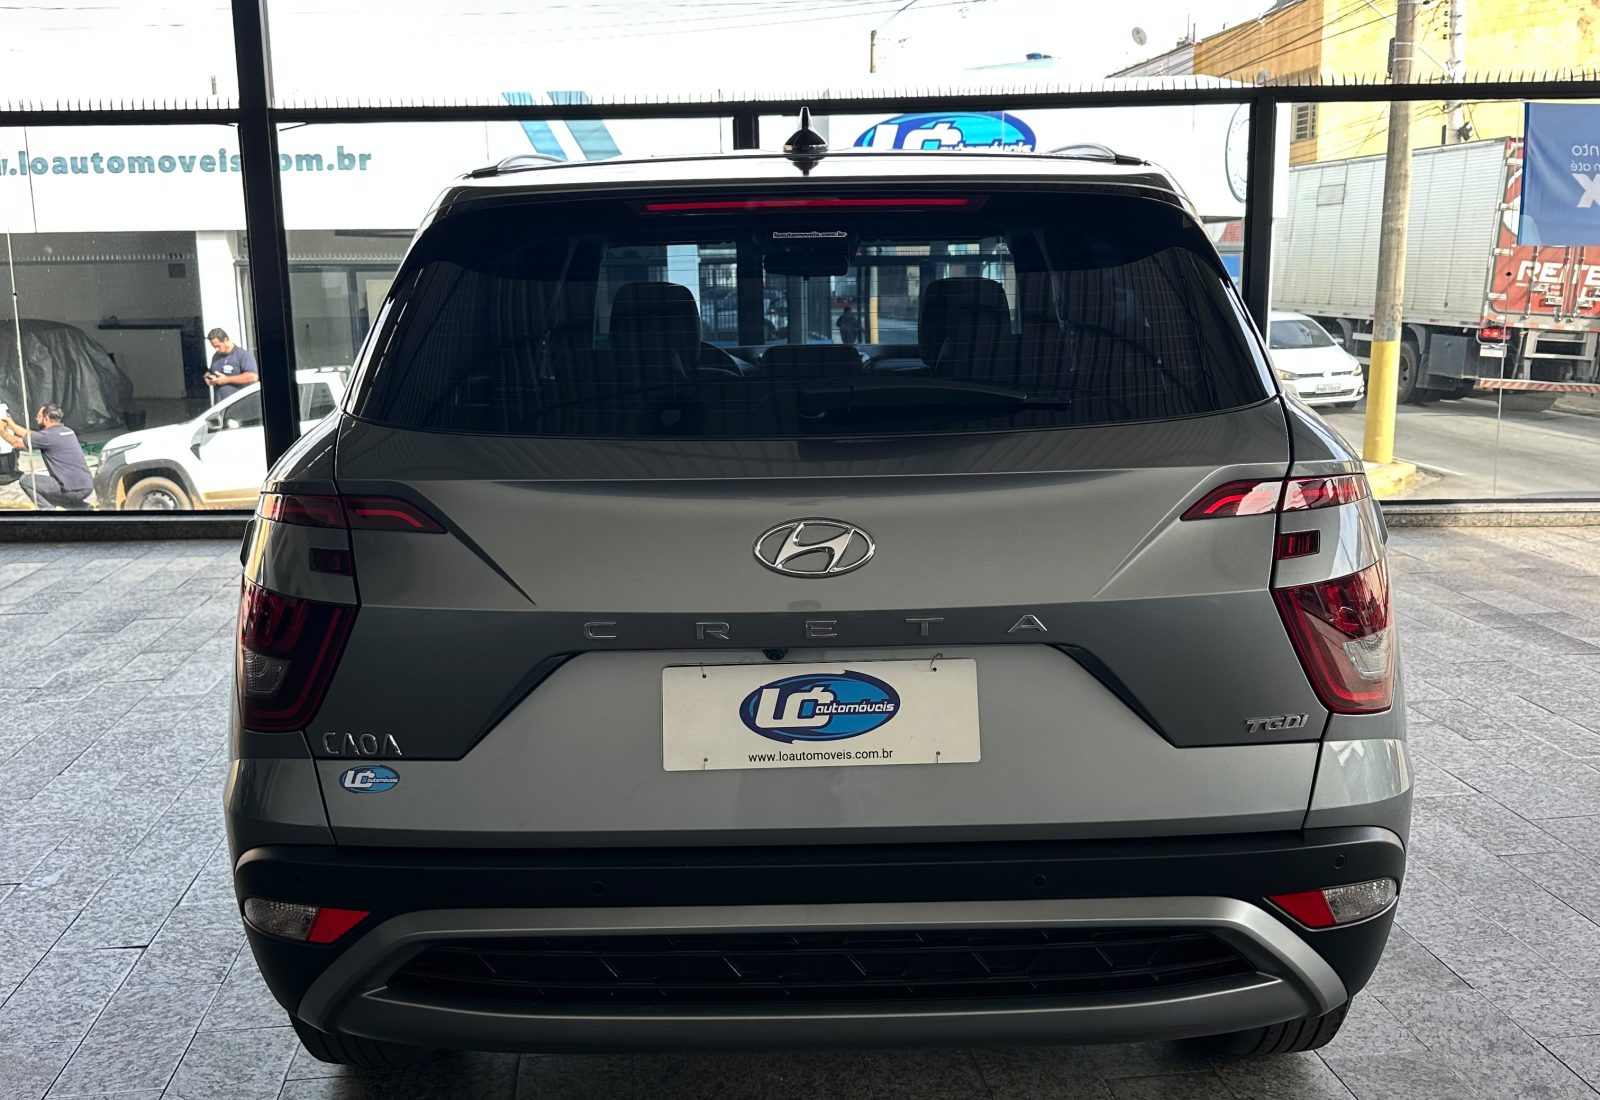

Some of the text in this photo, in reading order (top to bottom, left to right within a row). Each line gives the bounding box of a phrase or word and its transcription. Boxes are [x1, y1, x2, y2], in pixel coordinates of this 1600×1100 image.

[583, 614, 1048, 641] CRETA
[815, 701, 895, 714] automóveis
[322, 732, 403, 756] CAOA
[748, 748, 893, 762] www.loautomoveis.com.br
